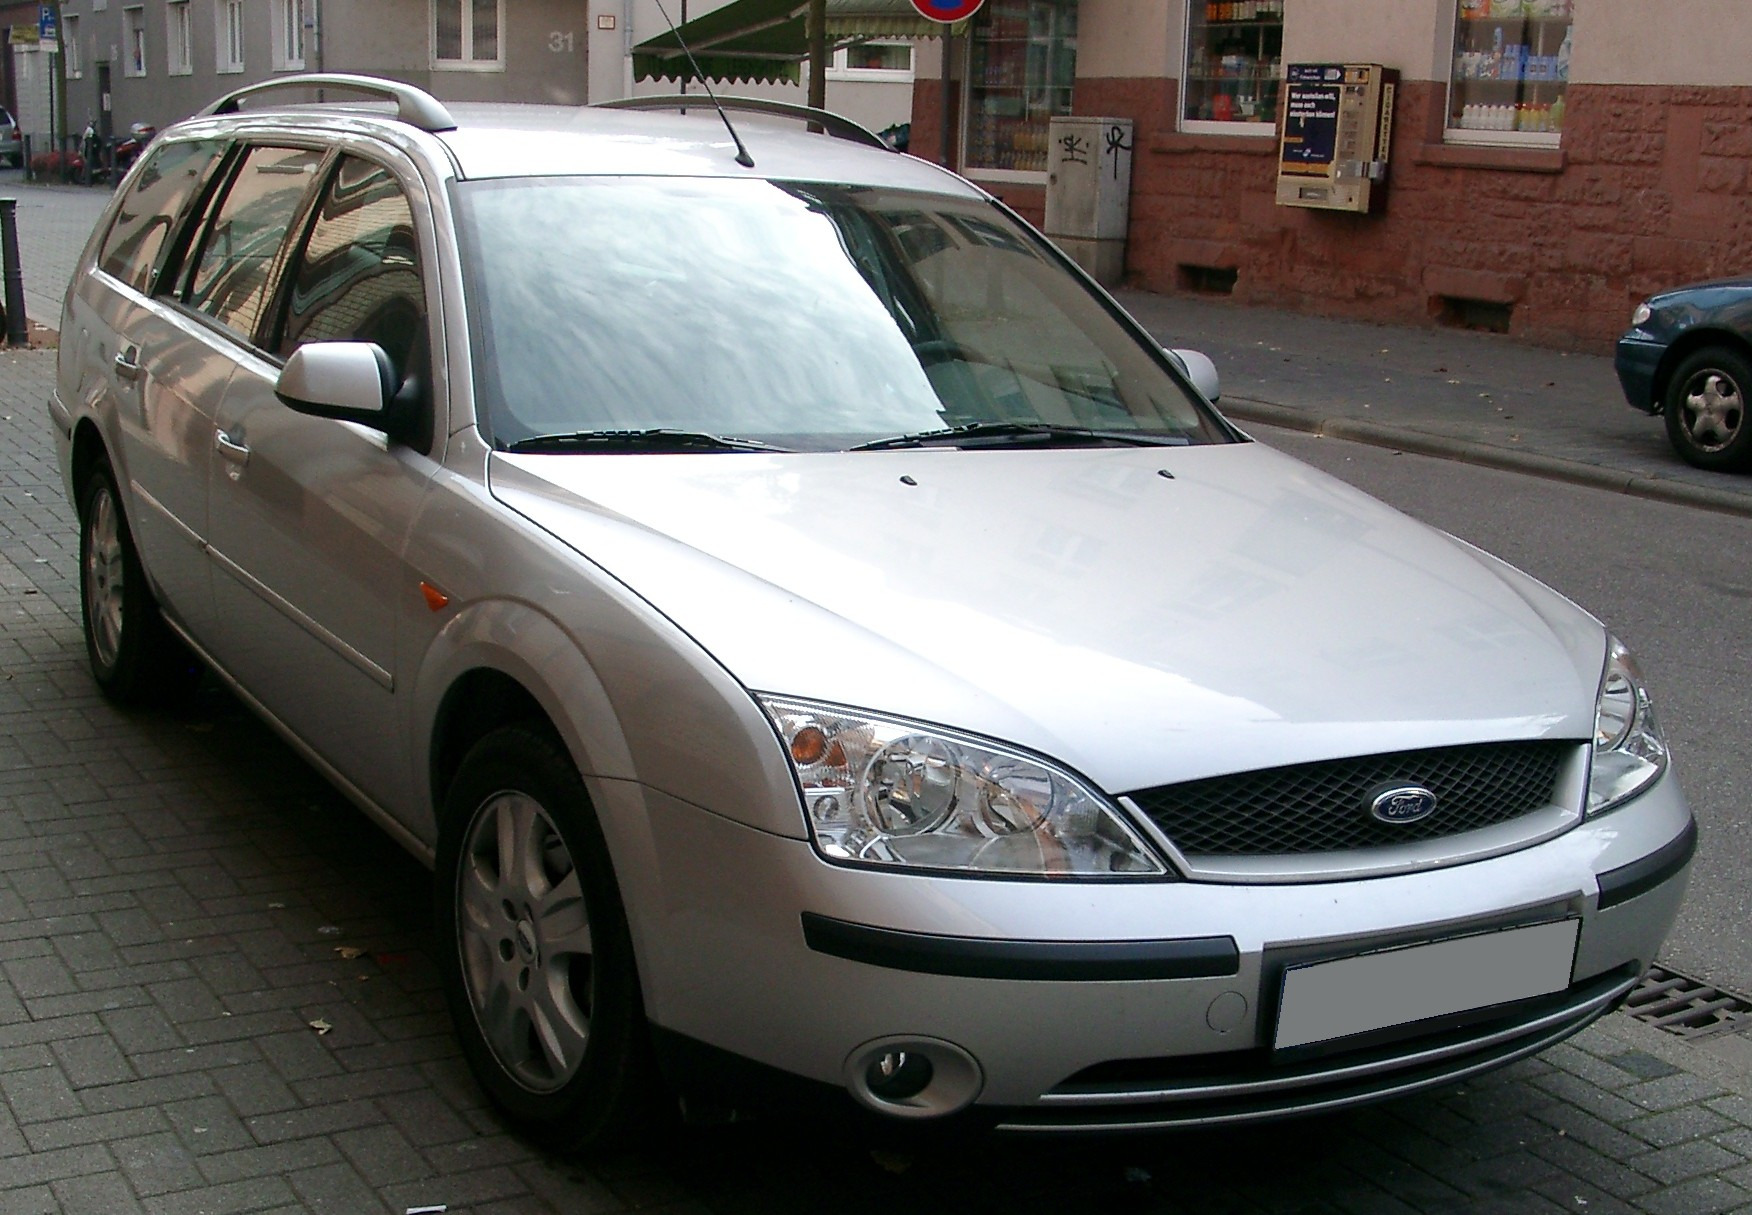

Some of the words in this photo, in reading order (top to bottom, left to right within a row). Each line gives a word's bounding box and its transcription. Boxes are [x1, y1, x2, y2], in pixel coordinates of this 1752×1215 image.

[42, 7, 50, 21] P
[548, 31, 573, 52] 31
[1388, 795, 1423, 815] Ford
